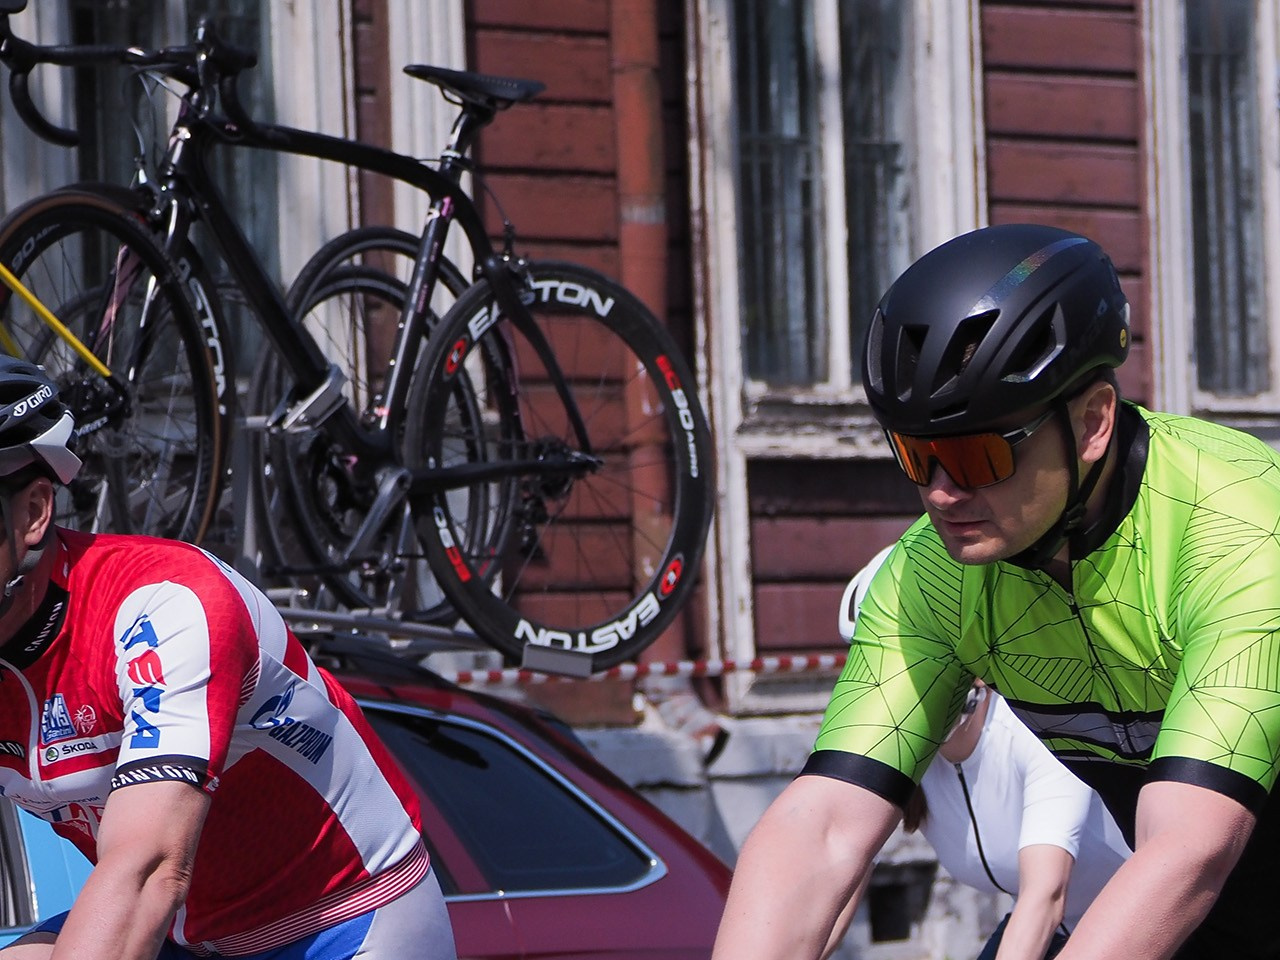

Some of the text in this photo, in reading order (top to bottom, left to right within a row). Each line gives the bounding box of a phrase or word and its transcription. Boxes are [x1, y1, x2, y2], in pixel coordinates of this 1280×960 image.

[27, 385, 53, 409] GIRO
[24, 601, 63, 653] CANYON
[61, 741, 98, 755] ŠKODA
[268, 720, 333, 765] GAZPROM
[110, 764, 199, 788] CANYON
